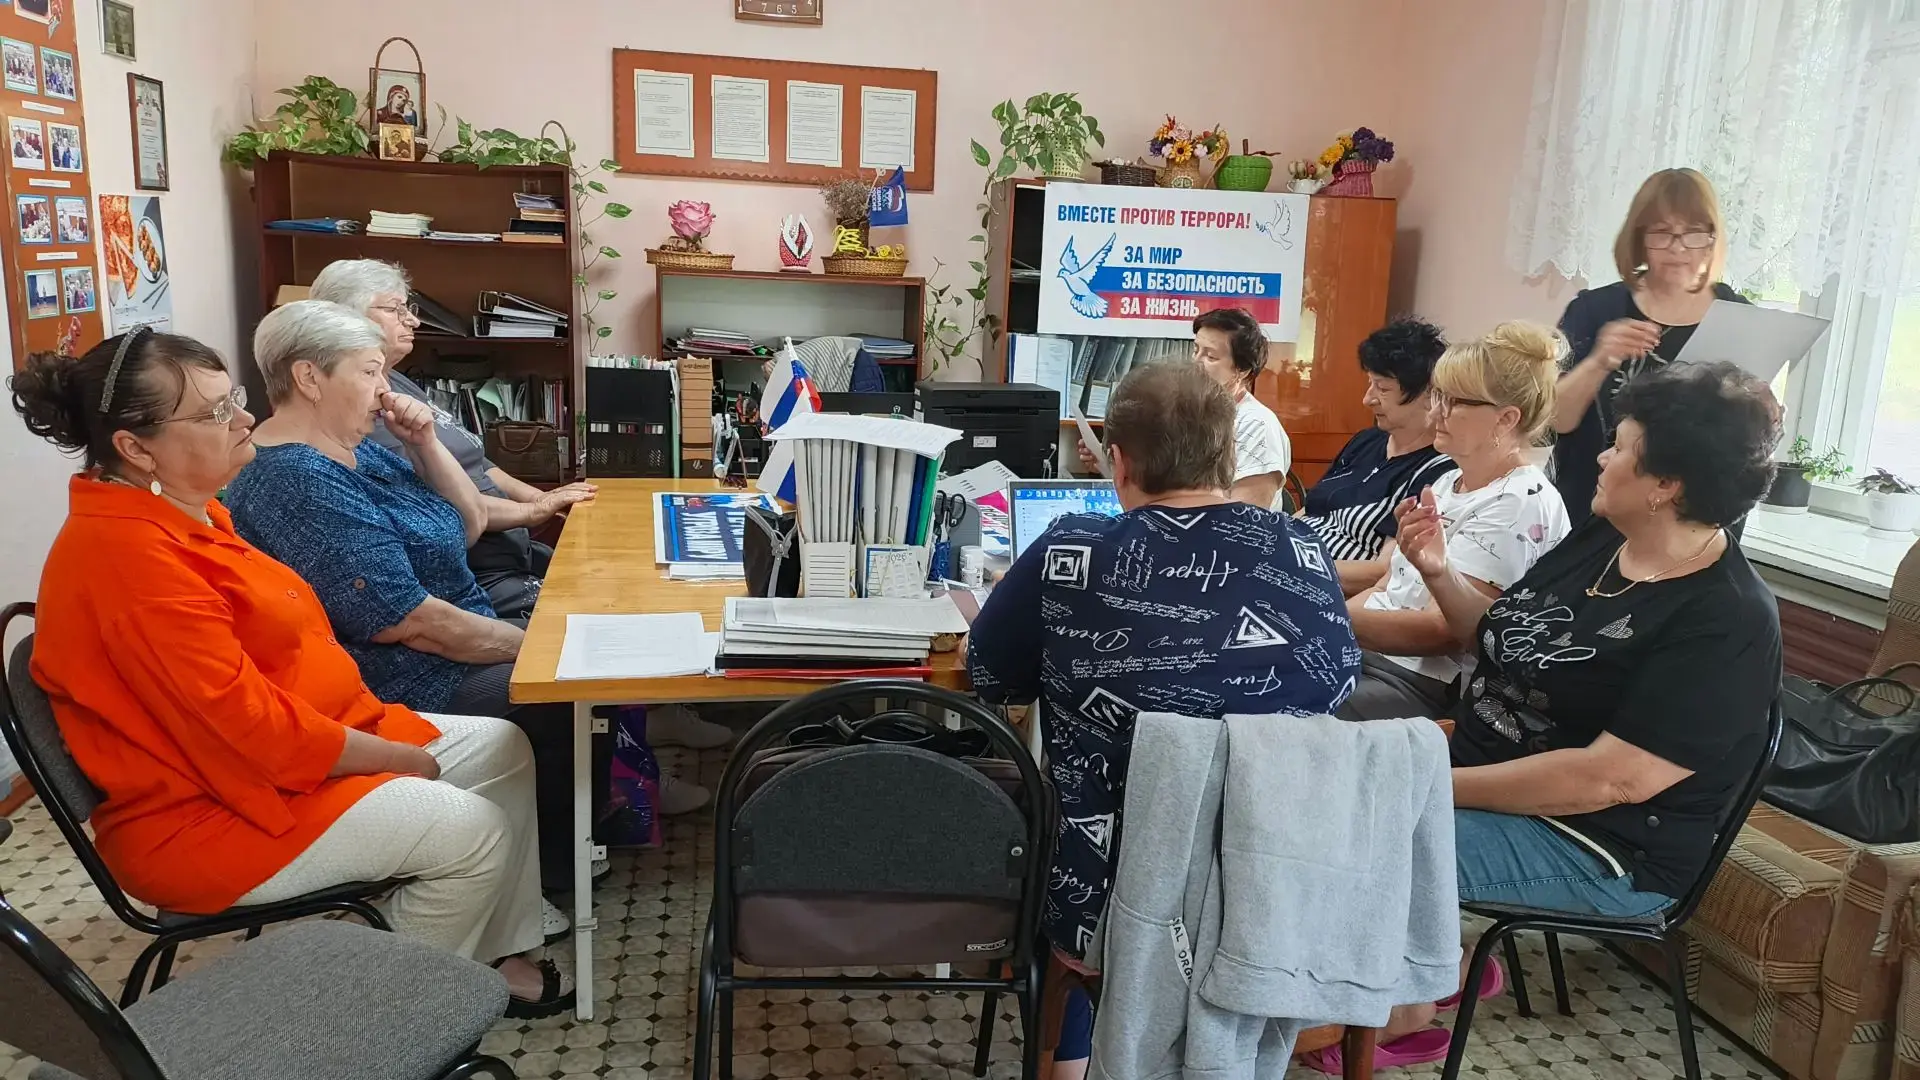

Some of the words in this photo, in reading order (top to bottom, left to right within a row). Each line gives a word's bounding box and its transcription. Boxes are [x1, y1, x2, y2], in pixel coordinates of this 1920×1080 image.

[1057, 204, 1116, 223] ВМЕСТЕ
[1120, 207, 1175, 226] ПРОТИВ
[1180, 210, 1251, 229] ТЕРРОРА!
[1124, 246, 1144, 263] ЗА
[1149, 246, 1182, 265] МИР
[1122, 271, 1142, 289] ЗА
[1147, 272, 1265, 294] БЕЗОПАСНОСТЬ
[1120, 297, 1141, 315] ЗА
[1145, 298, 1200, 317] ЖИЗНЬ
[1158, 550, 1239, 593] Hope
[1045, 625, 1132, 652] Dream
[1501, 627, 1596, 669] Girl
[1222, 666, 1282, 696] Fun
[1048, 865, 1100, 904] njoy
